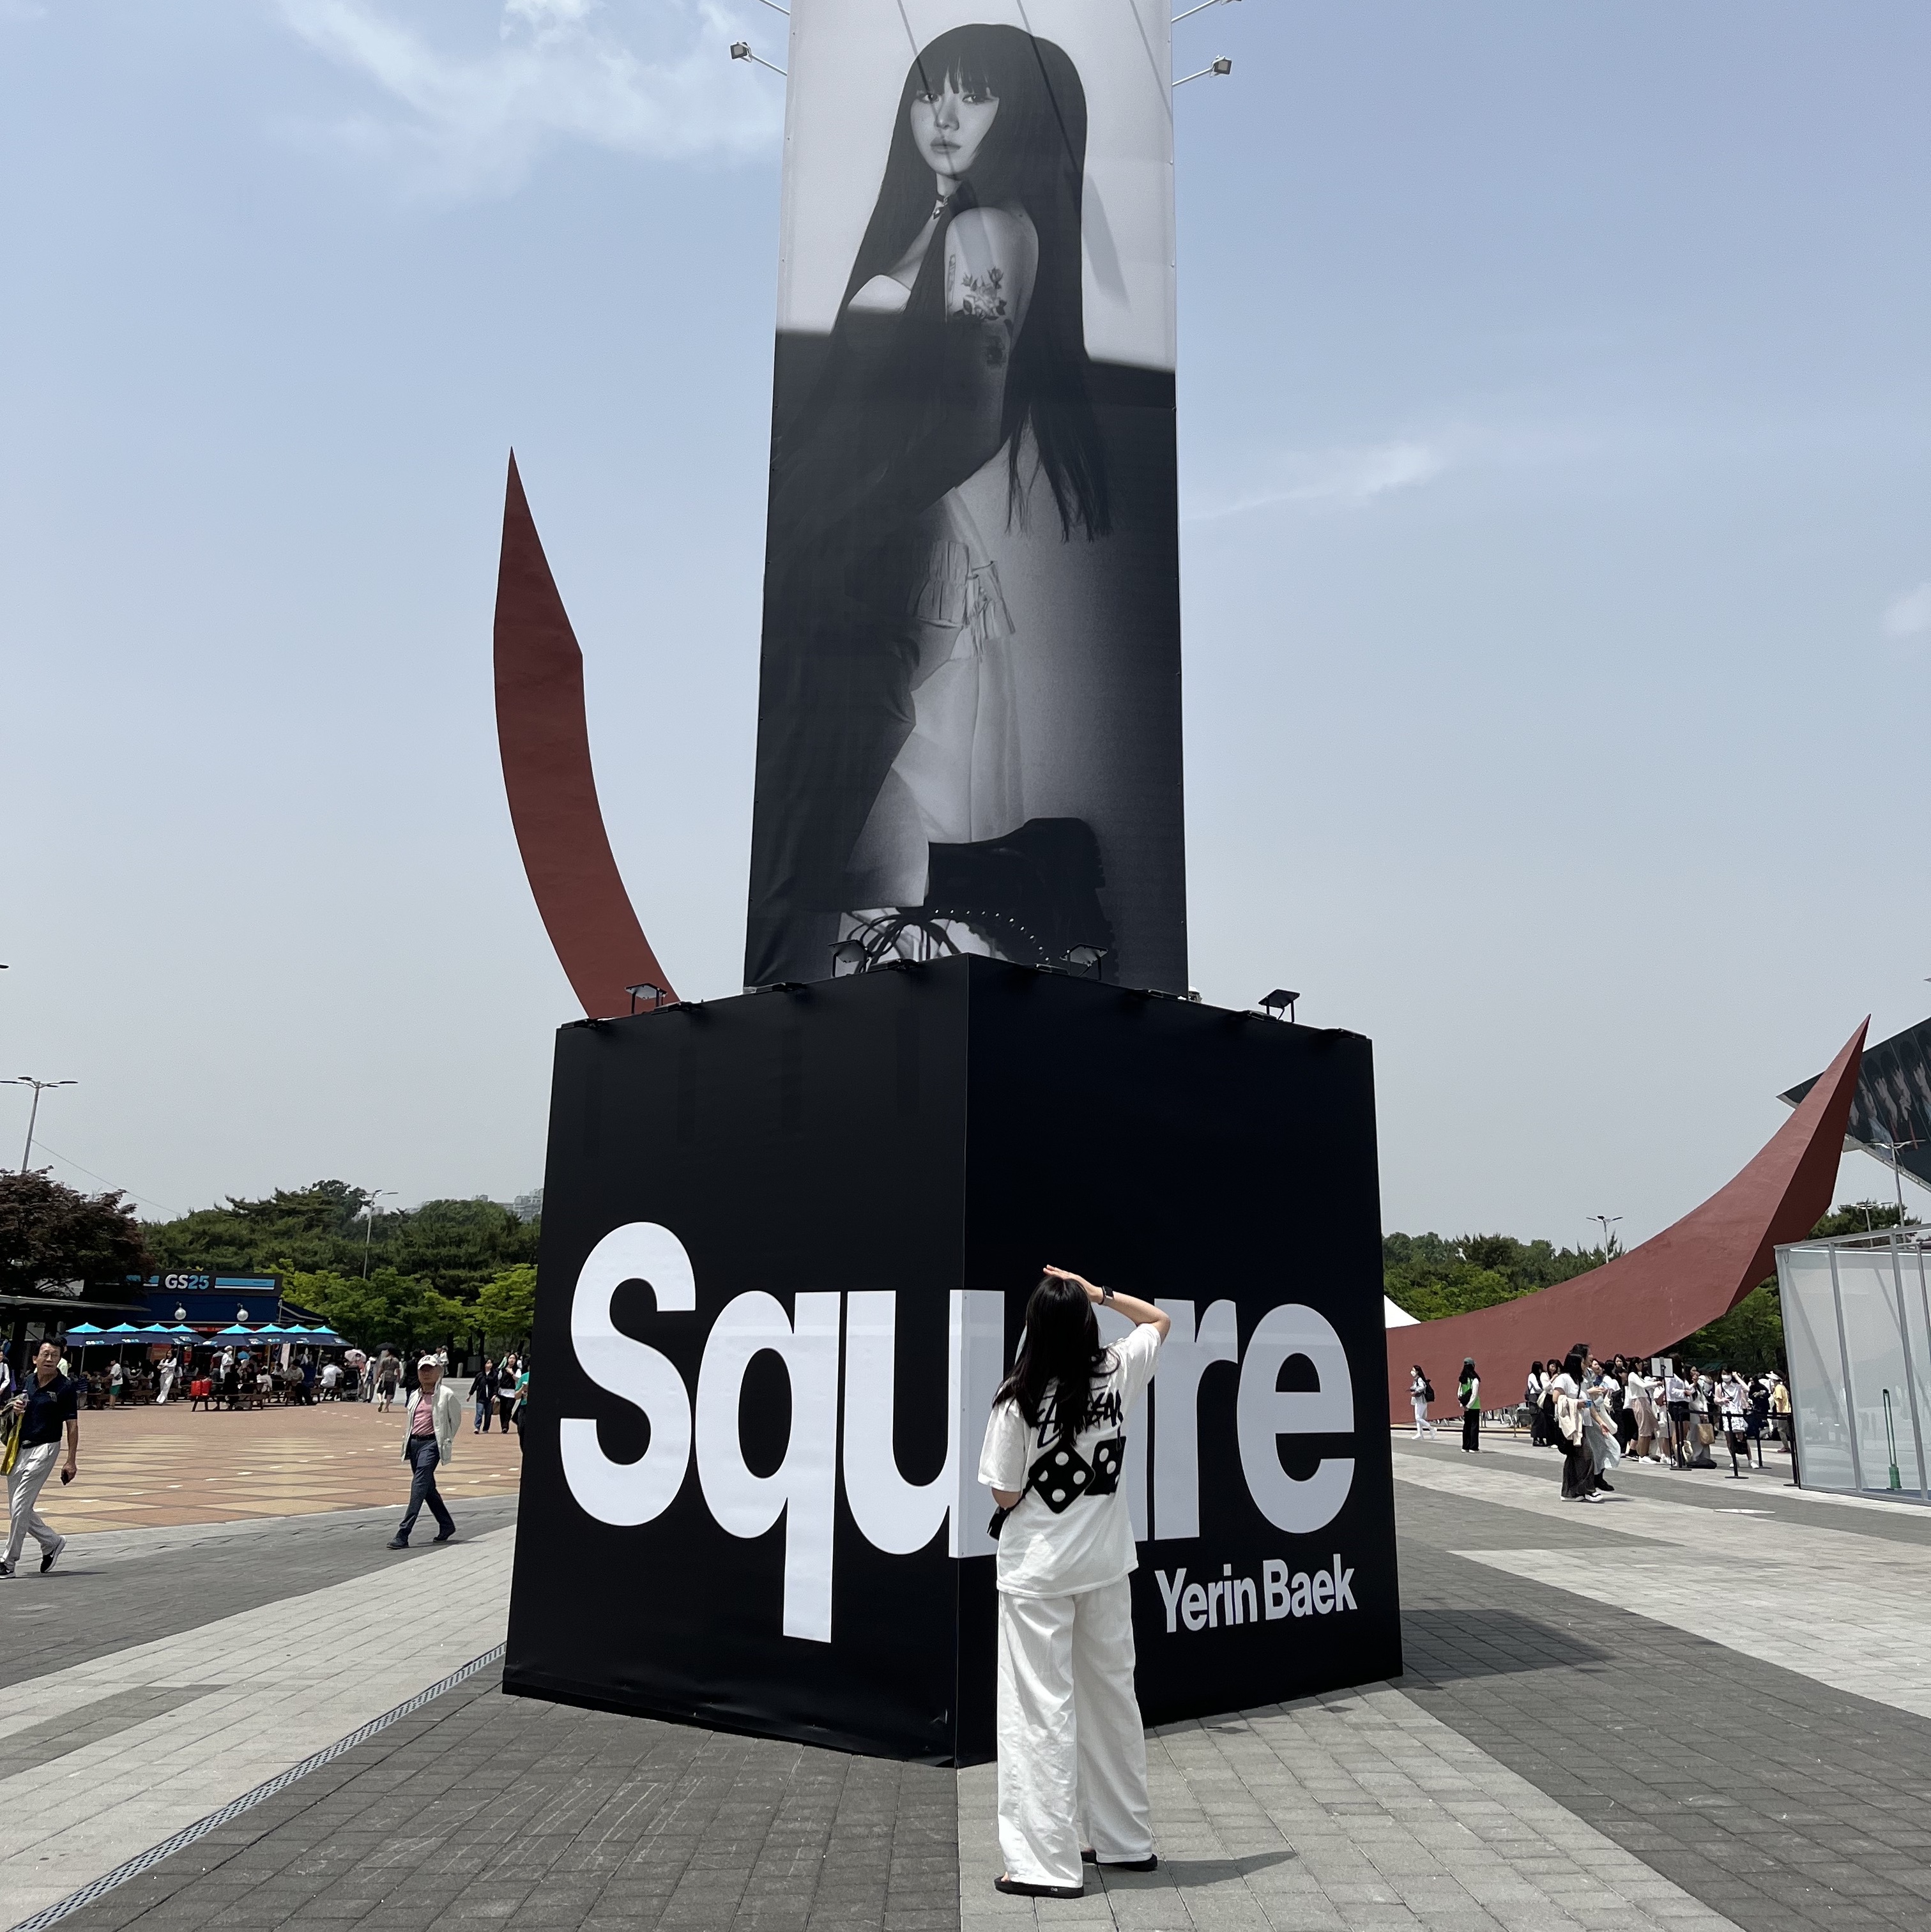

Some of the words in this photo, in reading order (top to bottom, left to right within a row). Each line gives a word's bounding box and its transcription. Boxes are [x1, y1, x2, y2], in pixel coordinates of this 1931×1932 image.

[165, 1274, 210, 1289] GS25
[1154, 1563, 1258, 1633] Yerin
[1263, 1553, 1358, 1621] Baek
